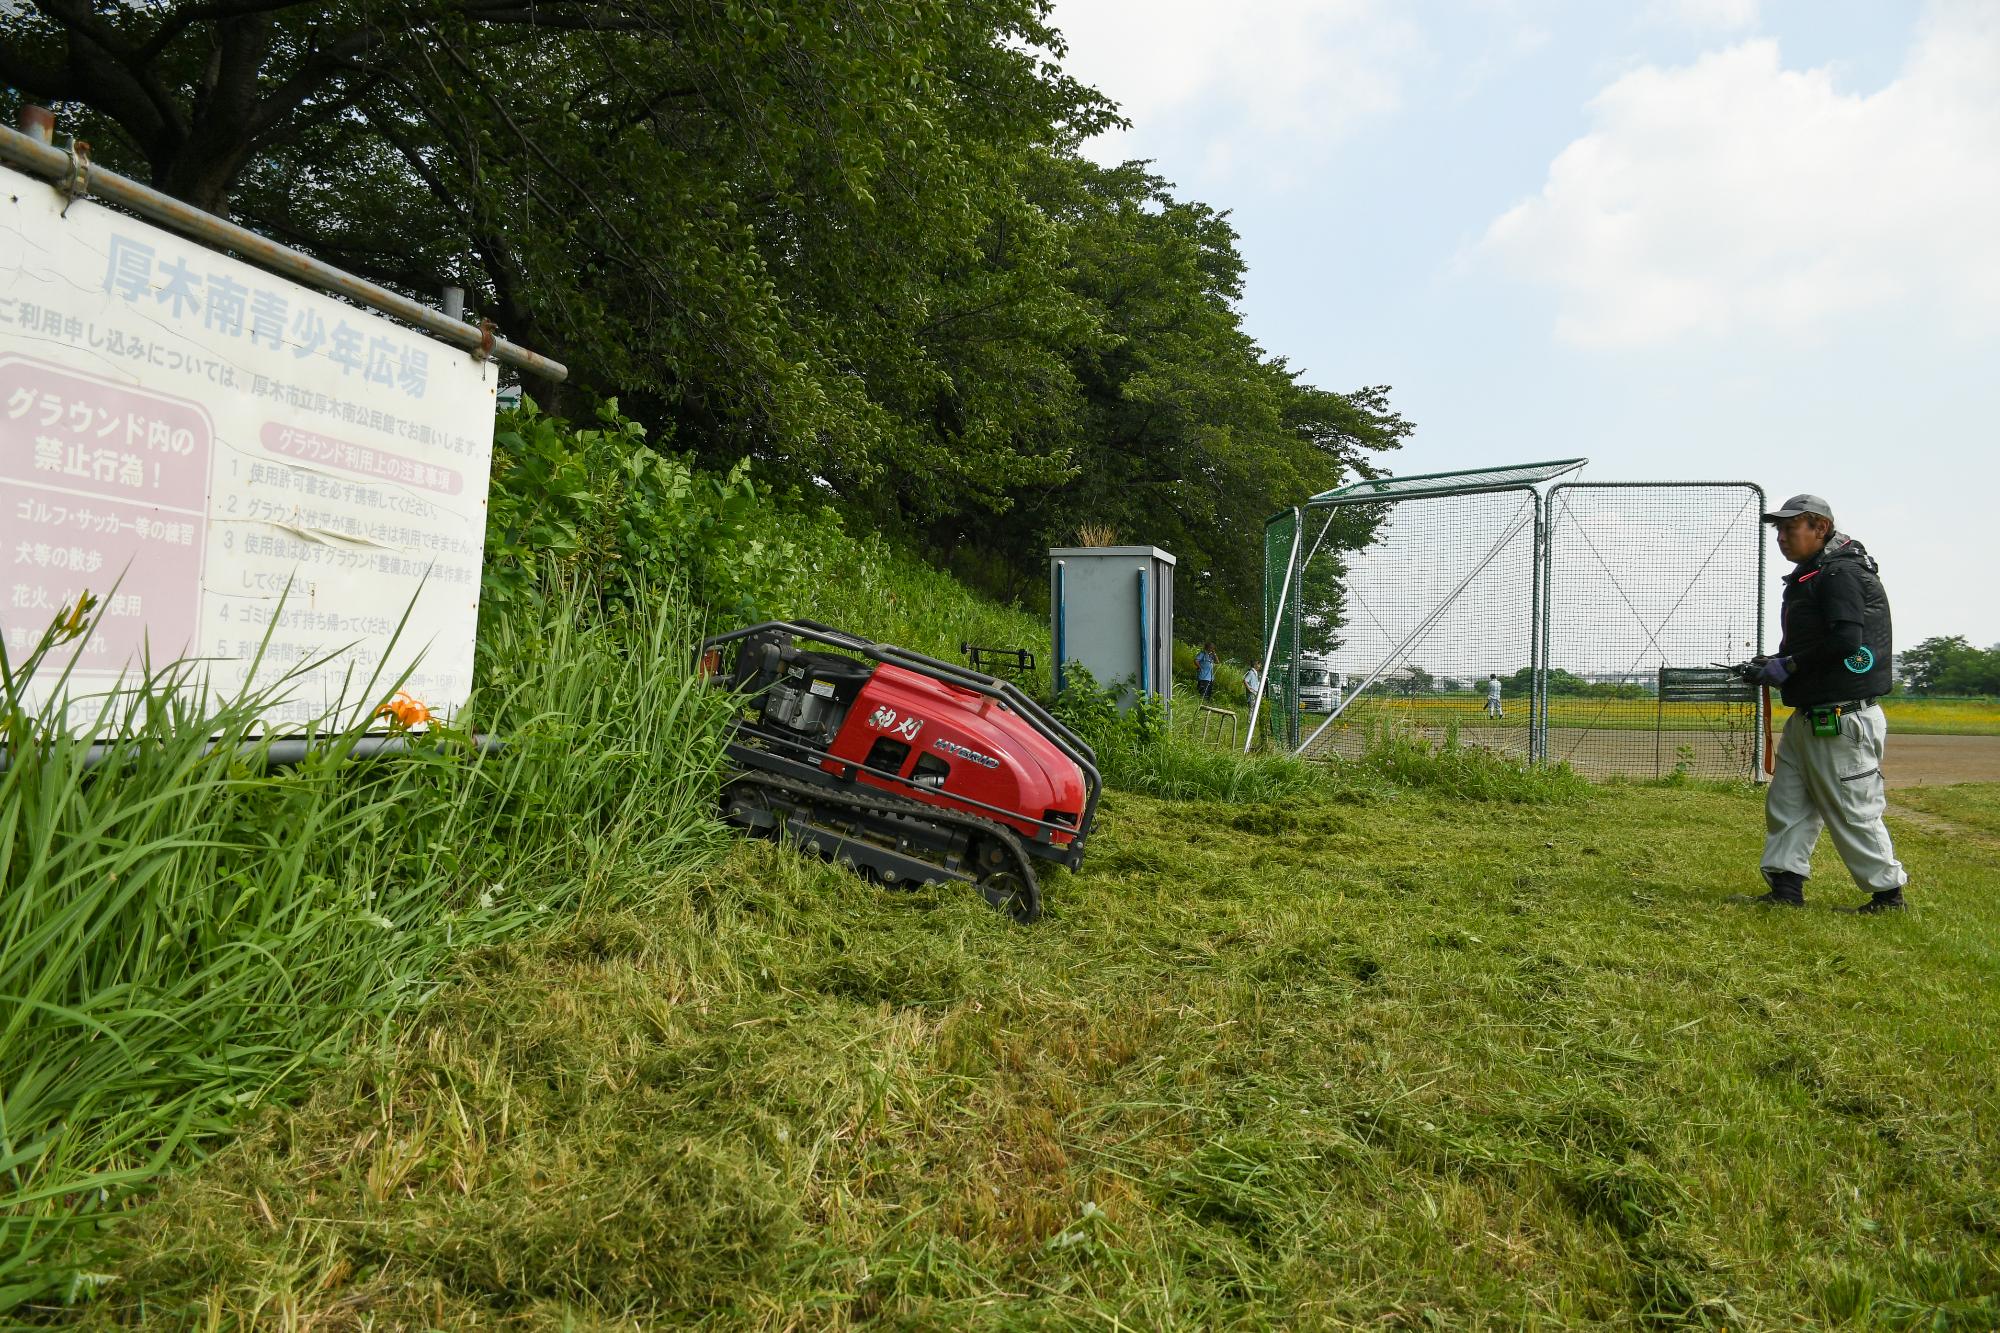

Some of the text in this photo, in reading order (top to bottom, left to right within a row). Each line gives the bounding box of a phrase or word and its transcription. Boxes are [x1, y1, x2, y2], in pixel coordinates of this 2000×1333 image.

[104, 232, 430, 401] 厚木南青少年広場
[8, 386, 195, 456] グラウンド内の
[279, 429, 450, 490] グラウンド利用上の注意事項
[14, 542, 104, 573] 犬等の散歩
[933, 738, 1000, 769] HYBRID
